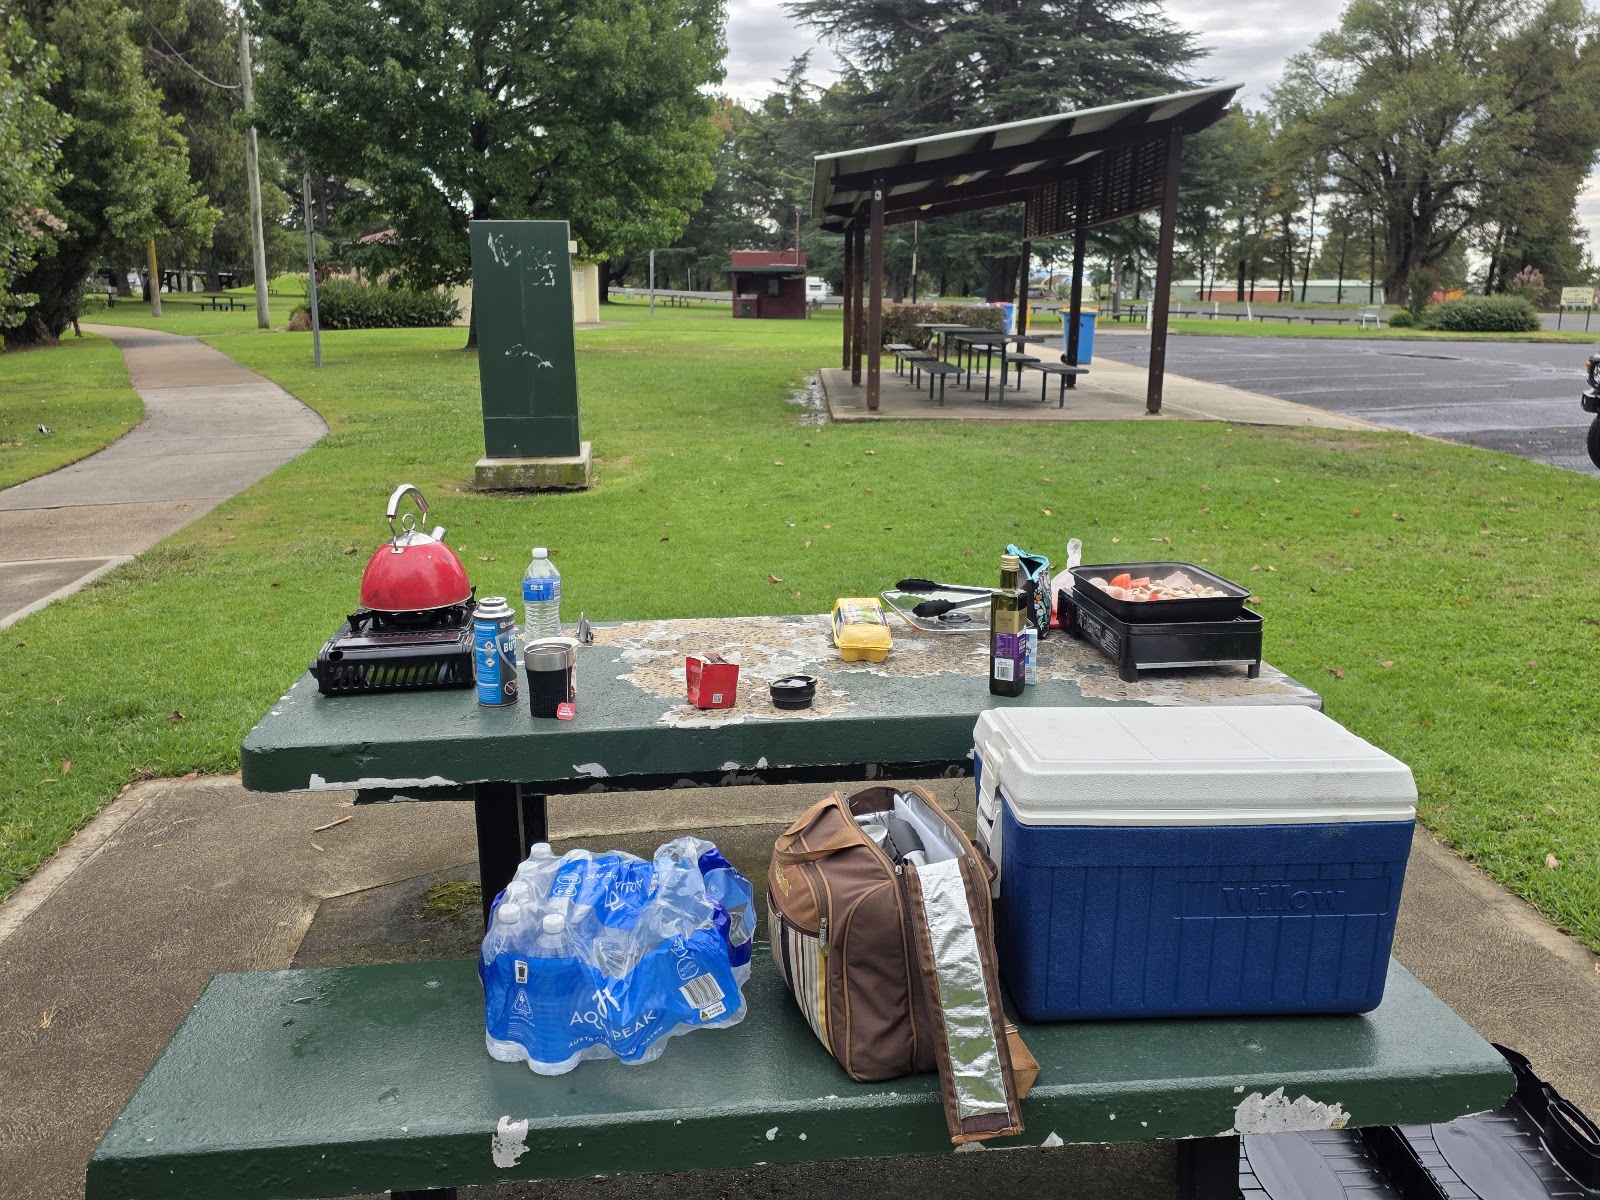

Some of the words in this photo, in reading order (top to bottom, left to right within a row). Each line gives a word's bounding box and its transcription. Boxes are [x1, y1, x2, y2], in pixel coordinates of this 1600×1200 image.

[615, 877, 644, 893] AQUA
[1222, 884, 1345, 912] Willow
[569, 1010, 603, 1029] AQ
[611, 1009, 657, 1041] PEAK
